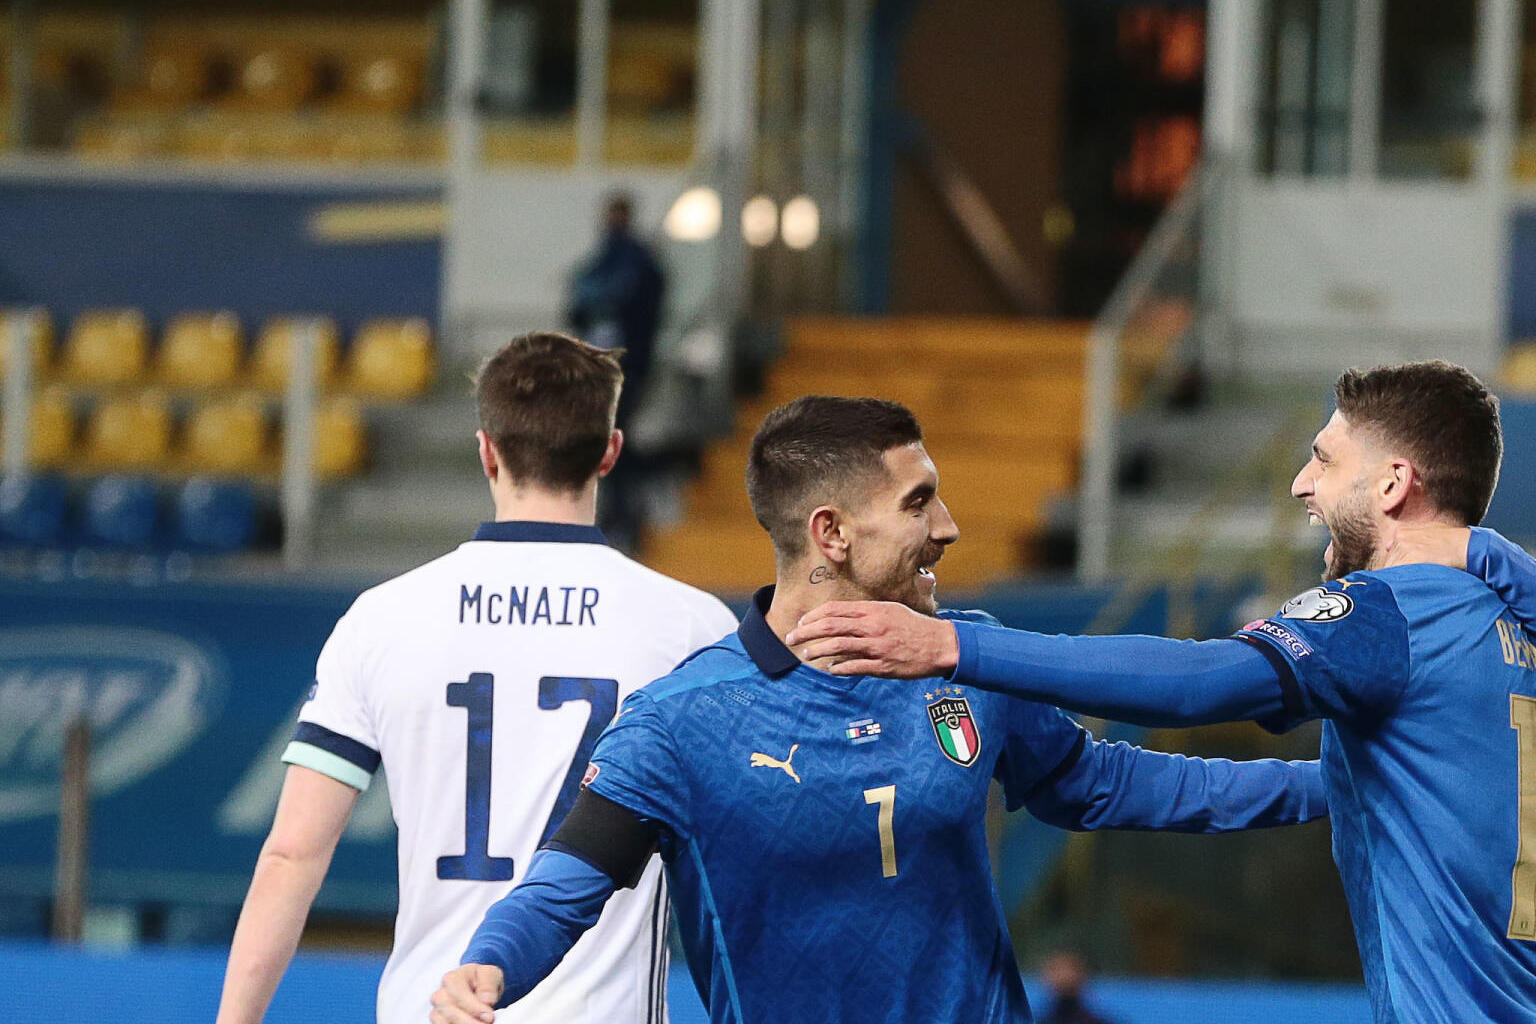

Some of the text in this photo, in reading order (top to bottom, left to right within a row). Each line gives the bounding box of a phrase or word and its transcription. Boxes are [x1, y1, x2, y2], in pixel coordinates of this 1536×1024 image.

[459, 585, 600, 626] McNAIR
[1260, 623, 1310, 656] RESPECT
[932, 703, 966, 718] ITALIA
[437, 673, 618, 881] 17
[863, 785, 897, 878] 7
